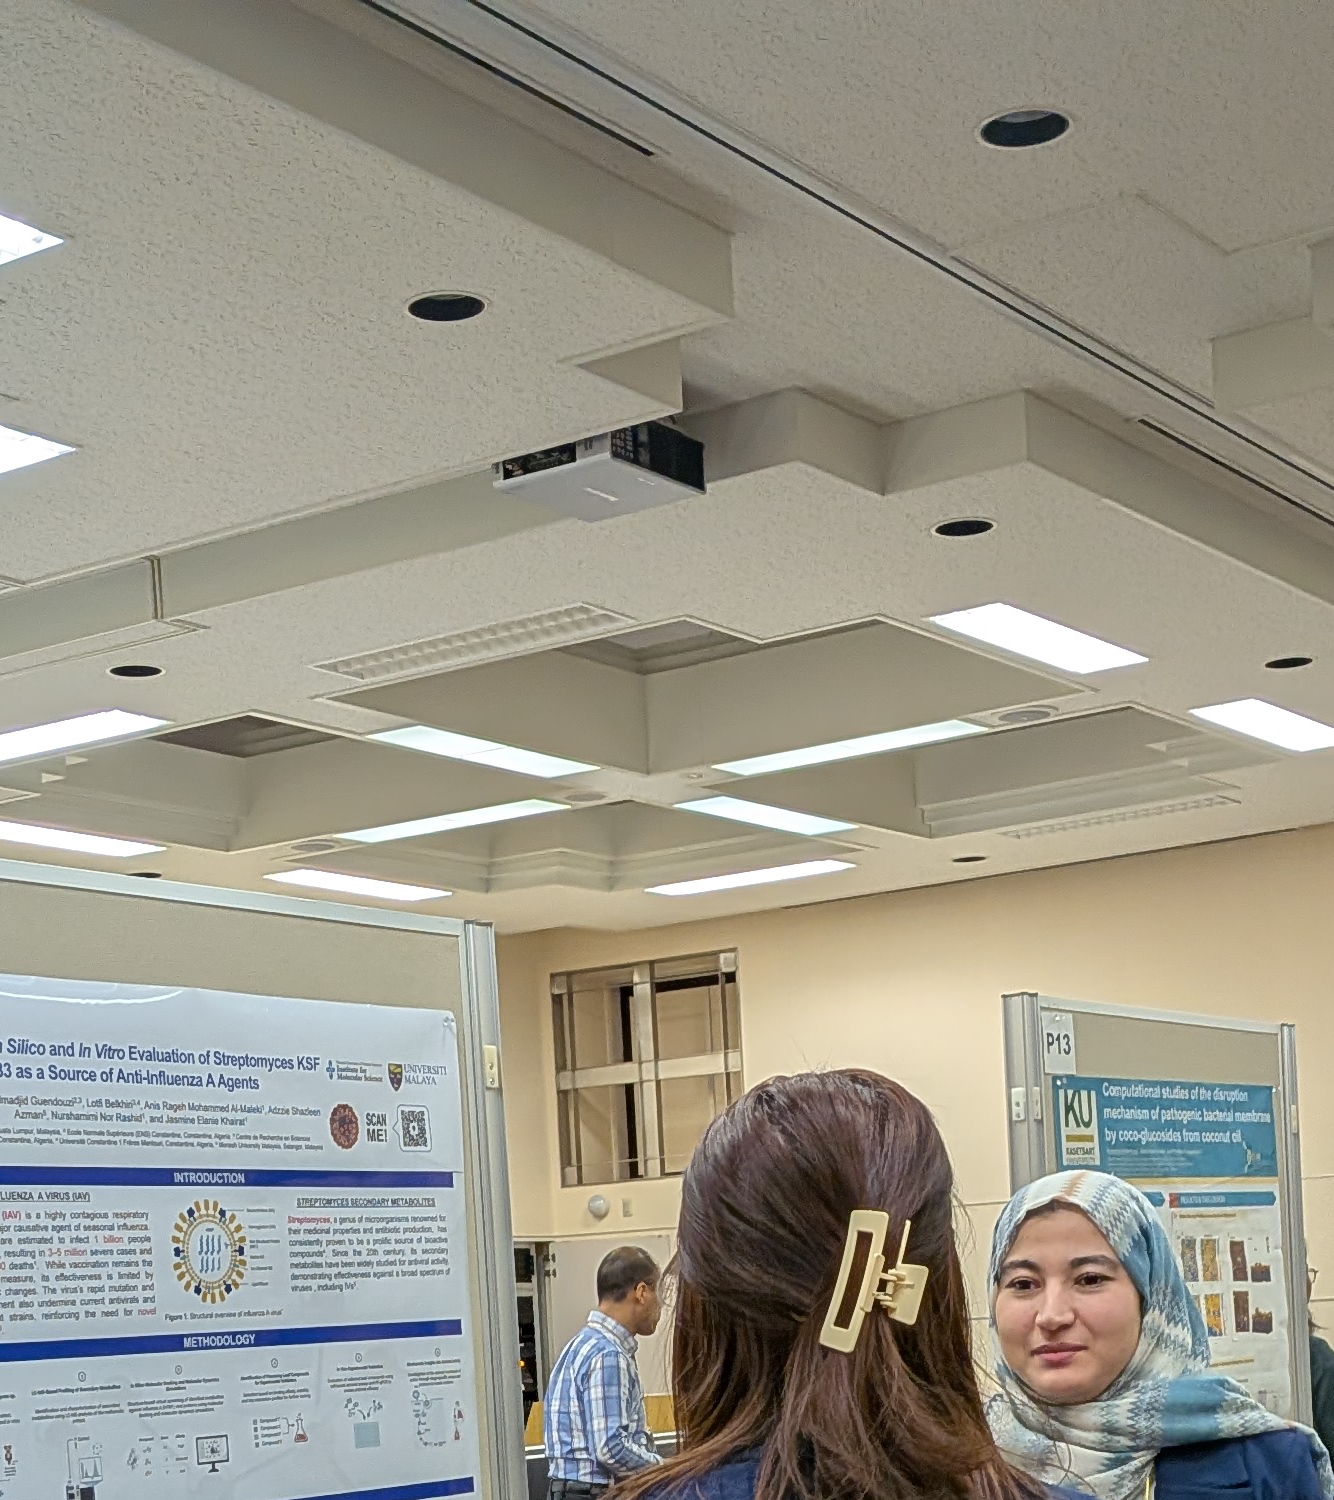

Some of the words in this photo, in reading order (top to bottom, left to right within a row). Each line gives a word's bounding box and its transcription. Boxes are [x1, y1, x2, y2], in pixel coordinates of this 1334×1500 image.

[1047, 1033, 1071, 1055] P13
[7, 1038, 46, 1055] Silico
[49, 1042, 74, 1057] and
[79, 1042, 91, 1057] In
[95, 1043, 125, 1060] Vitro
[129, 1046, 194, 1064] Evaluation
[198, 1050, 210, 1065] of
[214, 1051, 294, 1072] Streptomyces
[297, 1056, 320, 1071] KSF
[404, 1064, 447, 1075] UNIVERSITI
[16, 1066, 32, 1079] as
[36, 1067, 45, 1079] a
[48, 1065, 97, 1082] Source
[101, 1068, 114, 1083] of
[117, 1068, 203, 1087] Anti-Influenza
[206, 1073, 216, 1088] A
[218, 1074, 259, 1092] Agents
[405, 1075, 437, 1085] MALAYA
[1102, 1083, 1160, 1098] Computational
[1162, 1085, 1188, 1100] studies
[1191, 1087, 1199, 1100] of
[1200, 1087, 1211, 1100] the
[1213, 1088, 1248, 1102] disruption
[144, 1102, 160, 1110] Anis
[162, 1103, 186, 1112] Rageh
[188, 1103, 229, 1112] Mohammed
[1063, 1090, 1093, 1128] KU
[100, 1112, 114, 1122] Nor
[150, 1115, 163, 1123] and
[165, 1114, 195, 1124] Jasmine
[366, 1113, 386, 1126] SCAN
[1104, 1106, 1149, 1120] mechanism
[1151, 1106, 1159, 1120] of
[1161, 1108, 1201, 1124] pathogenic
[1204, 1109, 1233, 1122] bacterial
[367, 1128, 387, 1142] ME!
[1105, 1129, 1116, 1144] by
[1119, 1128, 1181, 1144] coco-glucosides
[1183, 1130, 1200, 1142] from
[1202, 1131, 1230, 1143] coconut
[1232, 1131, 1241, 1142] oil
[174, 1173, 245, 1183] INTRODUCTION
[38, 1192, 44, 1201] A
[46, 1192, 70, 1201] VIRUS
[73, 1193, 90, 1202] (IAV)
[2, 1210, 21, 1221] (IAV)
[25, 1211, 31, 1219] is
[45, 1210, 66, 1221] highly
[70, 1211, 109, 1221] contagious
[113, 1211, 149, 1221] respiratory
[14, 1224, 48, 1232] causative
[51, 1224, 71, 1233] agent
[74, 1223, 81, 1231] of
[83, 1223, 114, 1231] seasonal
[18, 1236, 53, 1245] estimated
[70, 1235, 90, 1244] infect
[103, 1235, 123, 1243] billion
[128, 1235, 151, 1245] people
[4, 1249, 36, 1259] resulting
[39, 1249, 46, 1257] in
[64, 1248, 87, 1256] million
[117, 1248, 136, 1256] cases
[184, 1334, 255, 1347] METHODOLOGY
